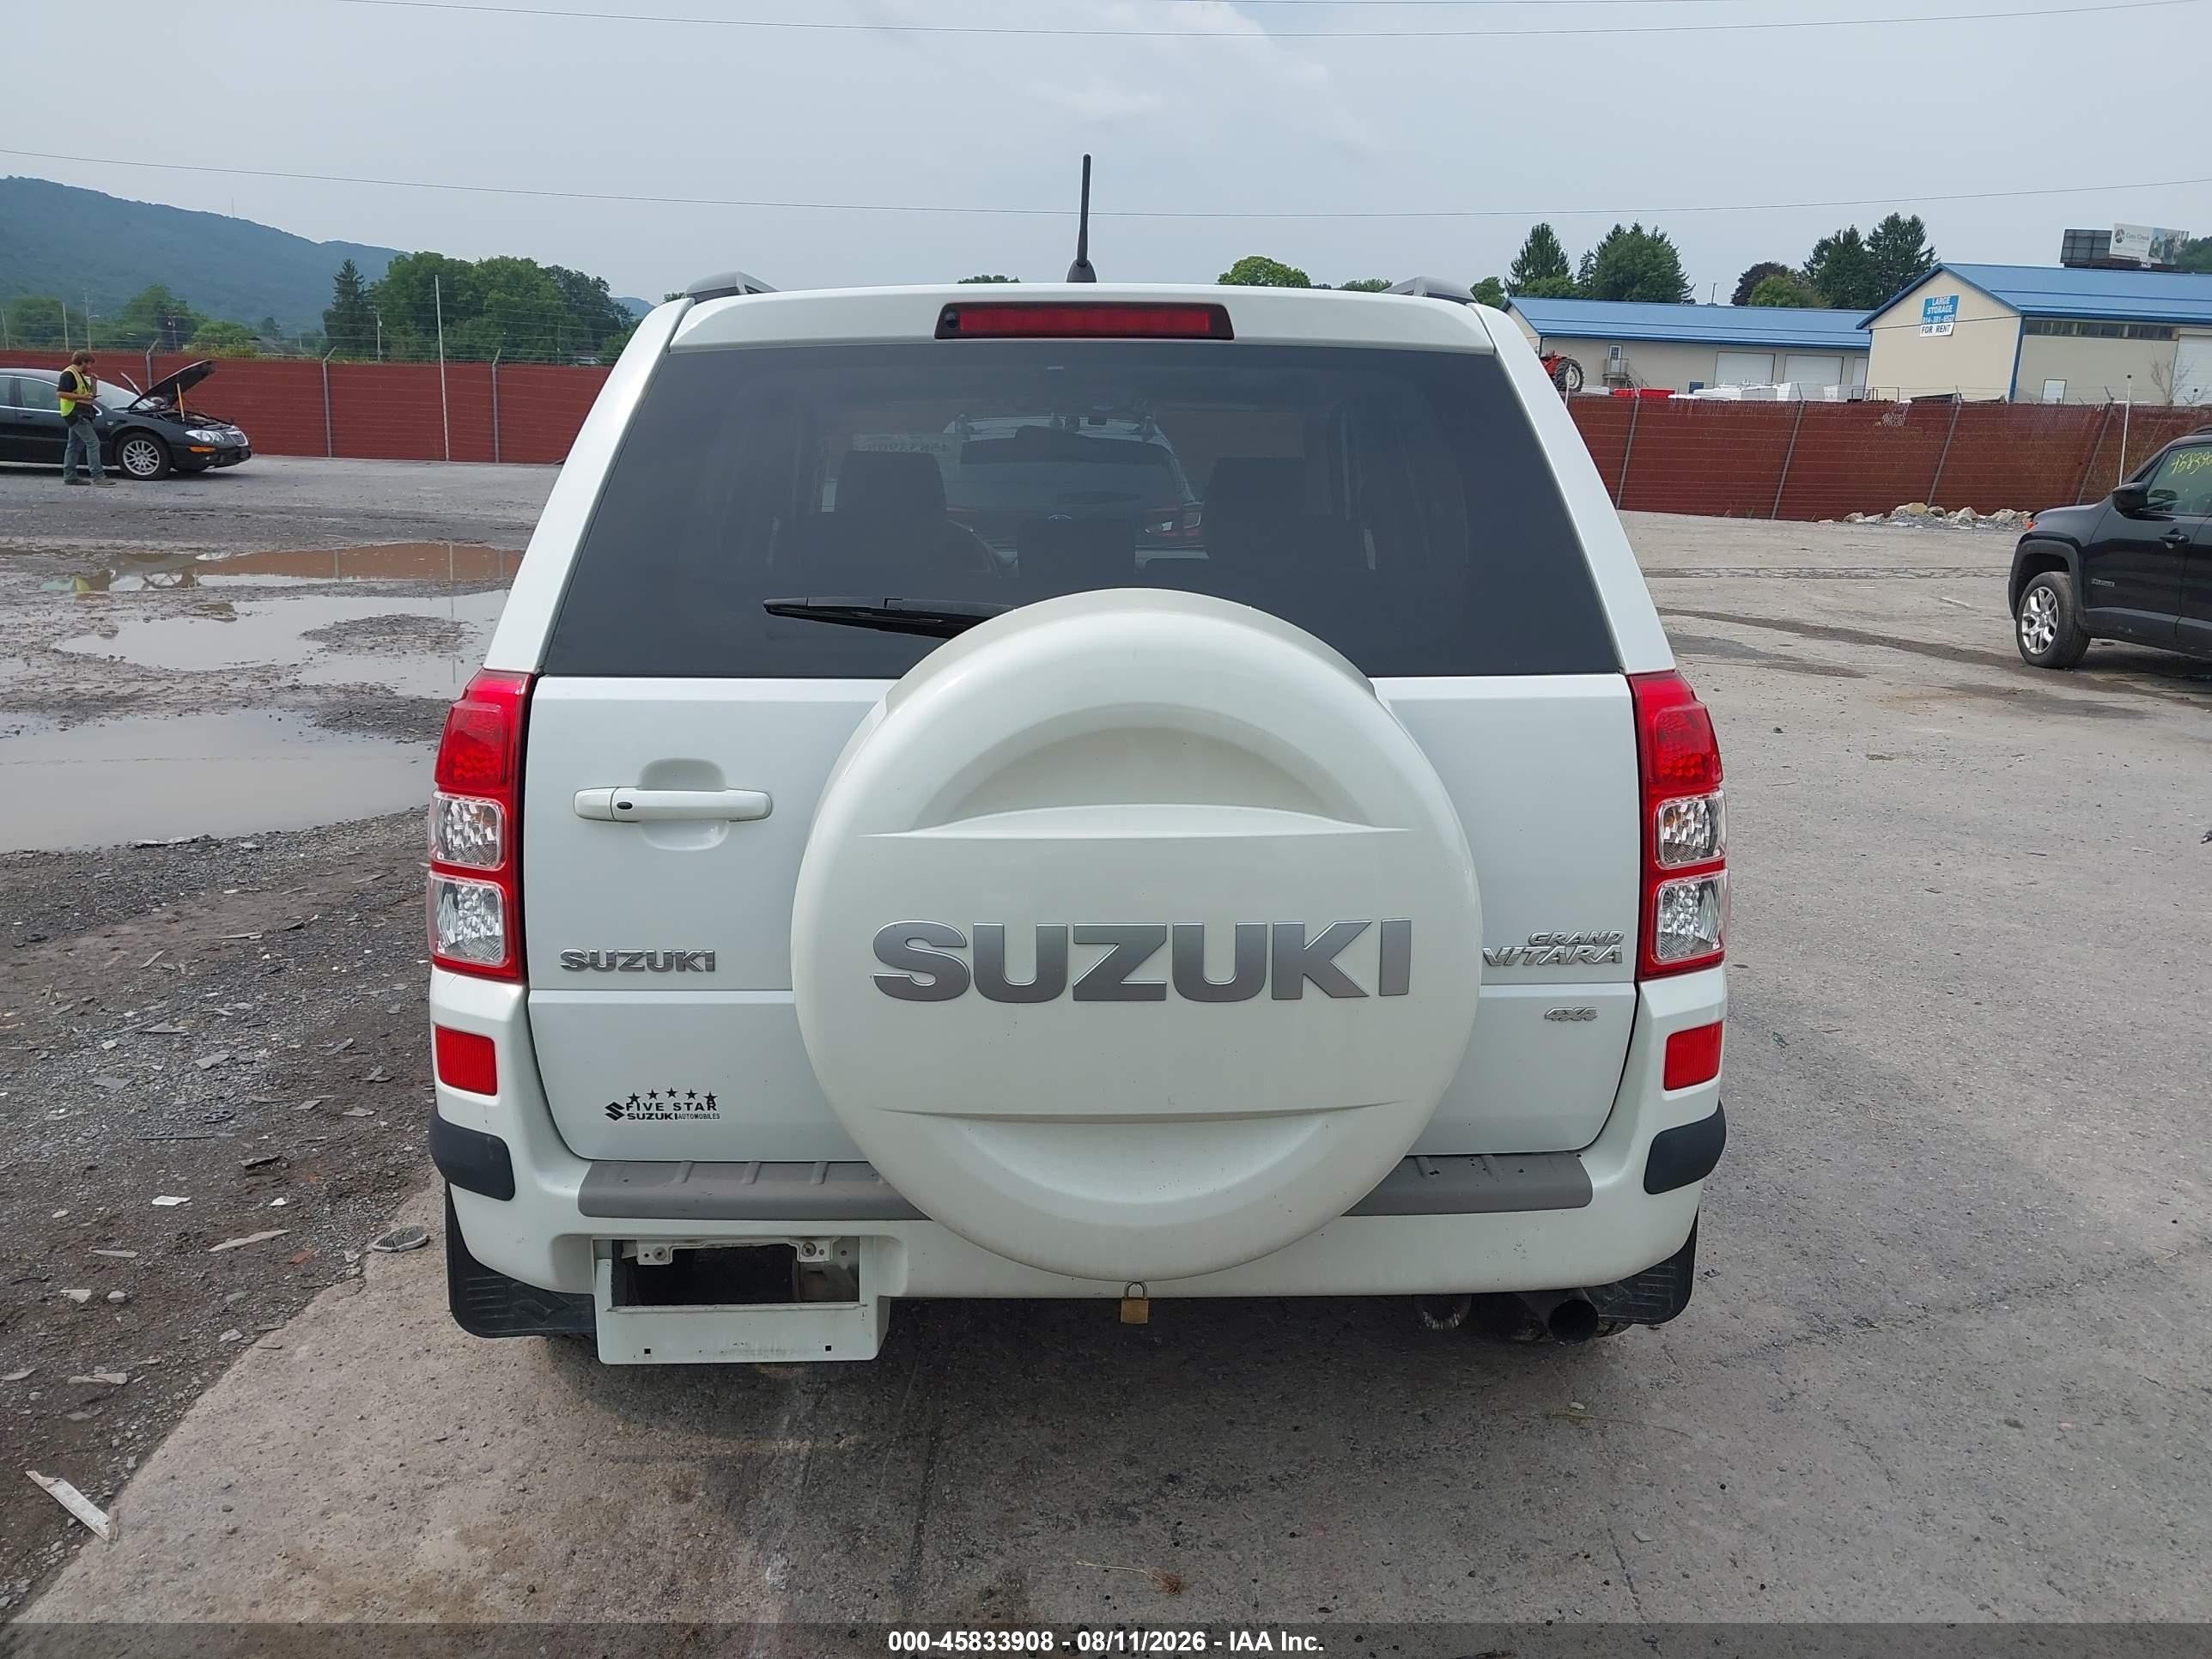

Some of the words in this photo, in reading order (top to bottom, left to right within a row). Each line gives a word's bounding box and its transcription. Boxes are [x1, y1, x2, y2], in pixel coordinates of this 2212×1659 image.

[1931, 296, 1951, 306] LARGE
[1927, 304, 1954, 314] STORAGE
[1922, 325, 1933, 334] FOR
[1936, 324, 1951, 333] RENT
[1528, 930, 1625, 946] GRAND
[560, 948, 716, 972] SUZUKI
[872, 918, 1413, 1004] SUZUKI
[1482, 945, 1623, 966] VITARA
[626, 1103, 665, 1111] FIVE
[672, 1101, 716, 1111] STAR
